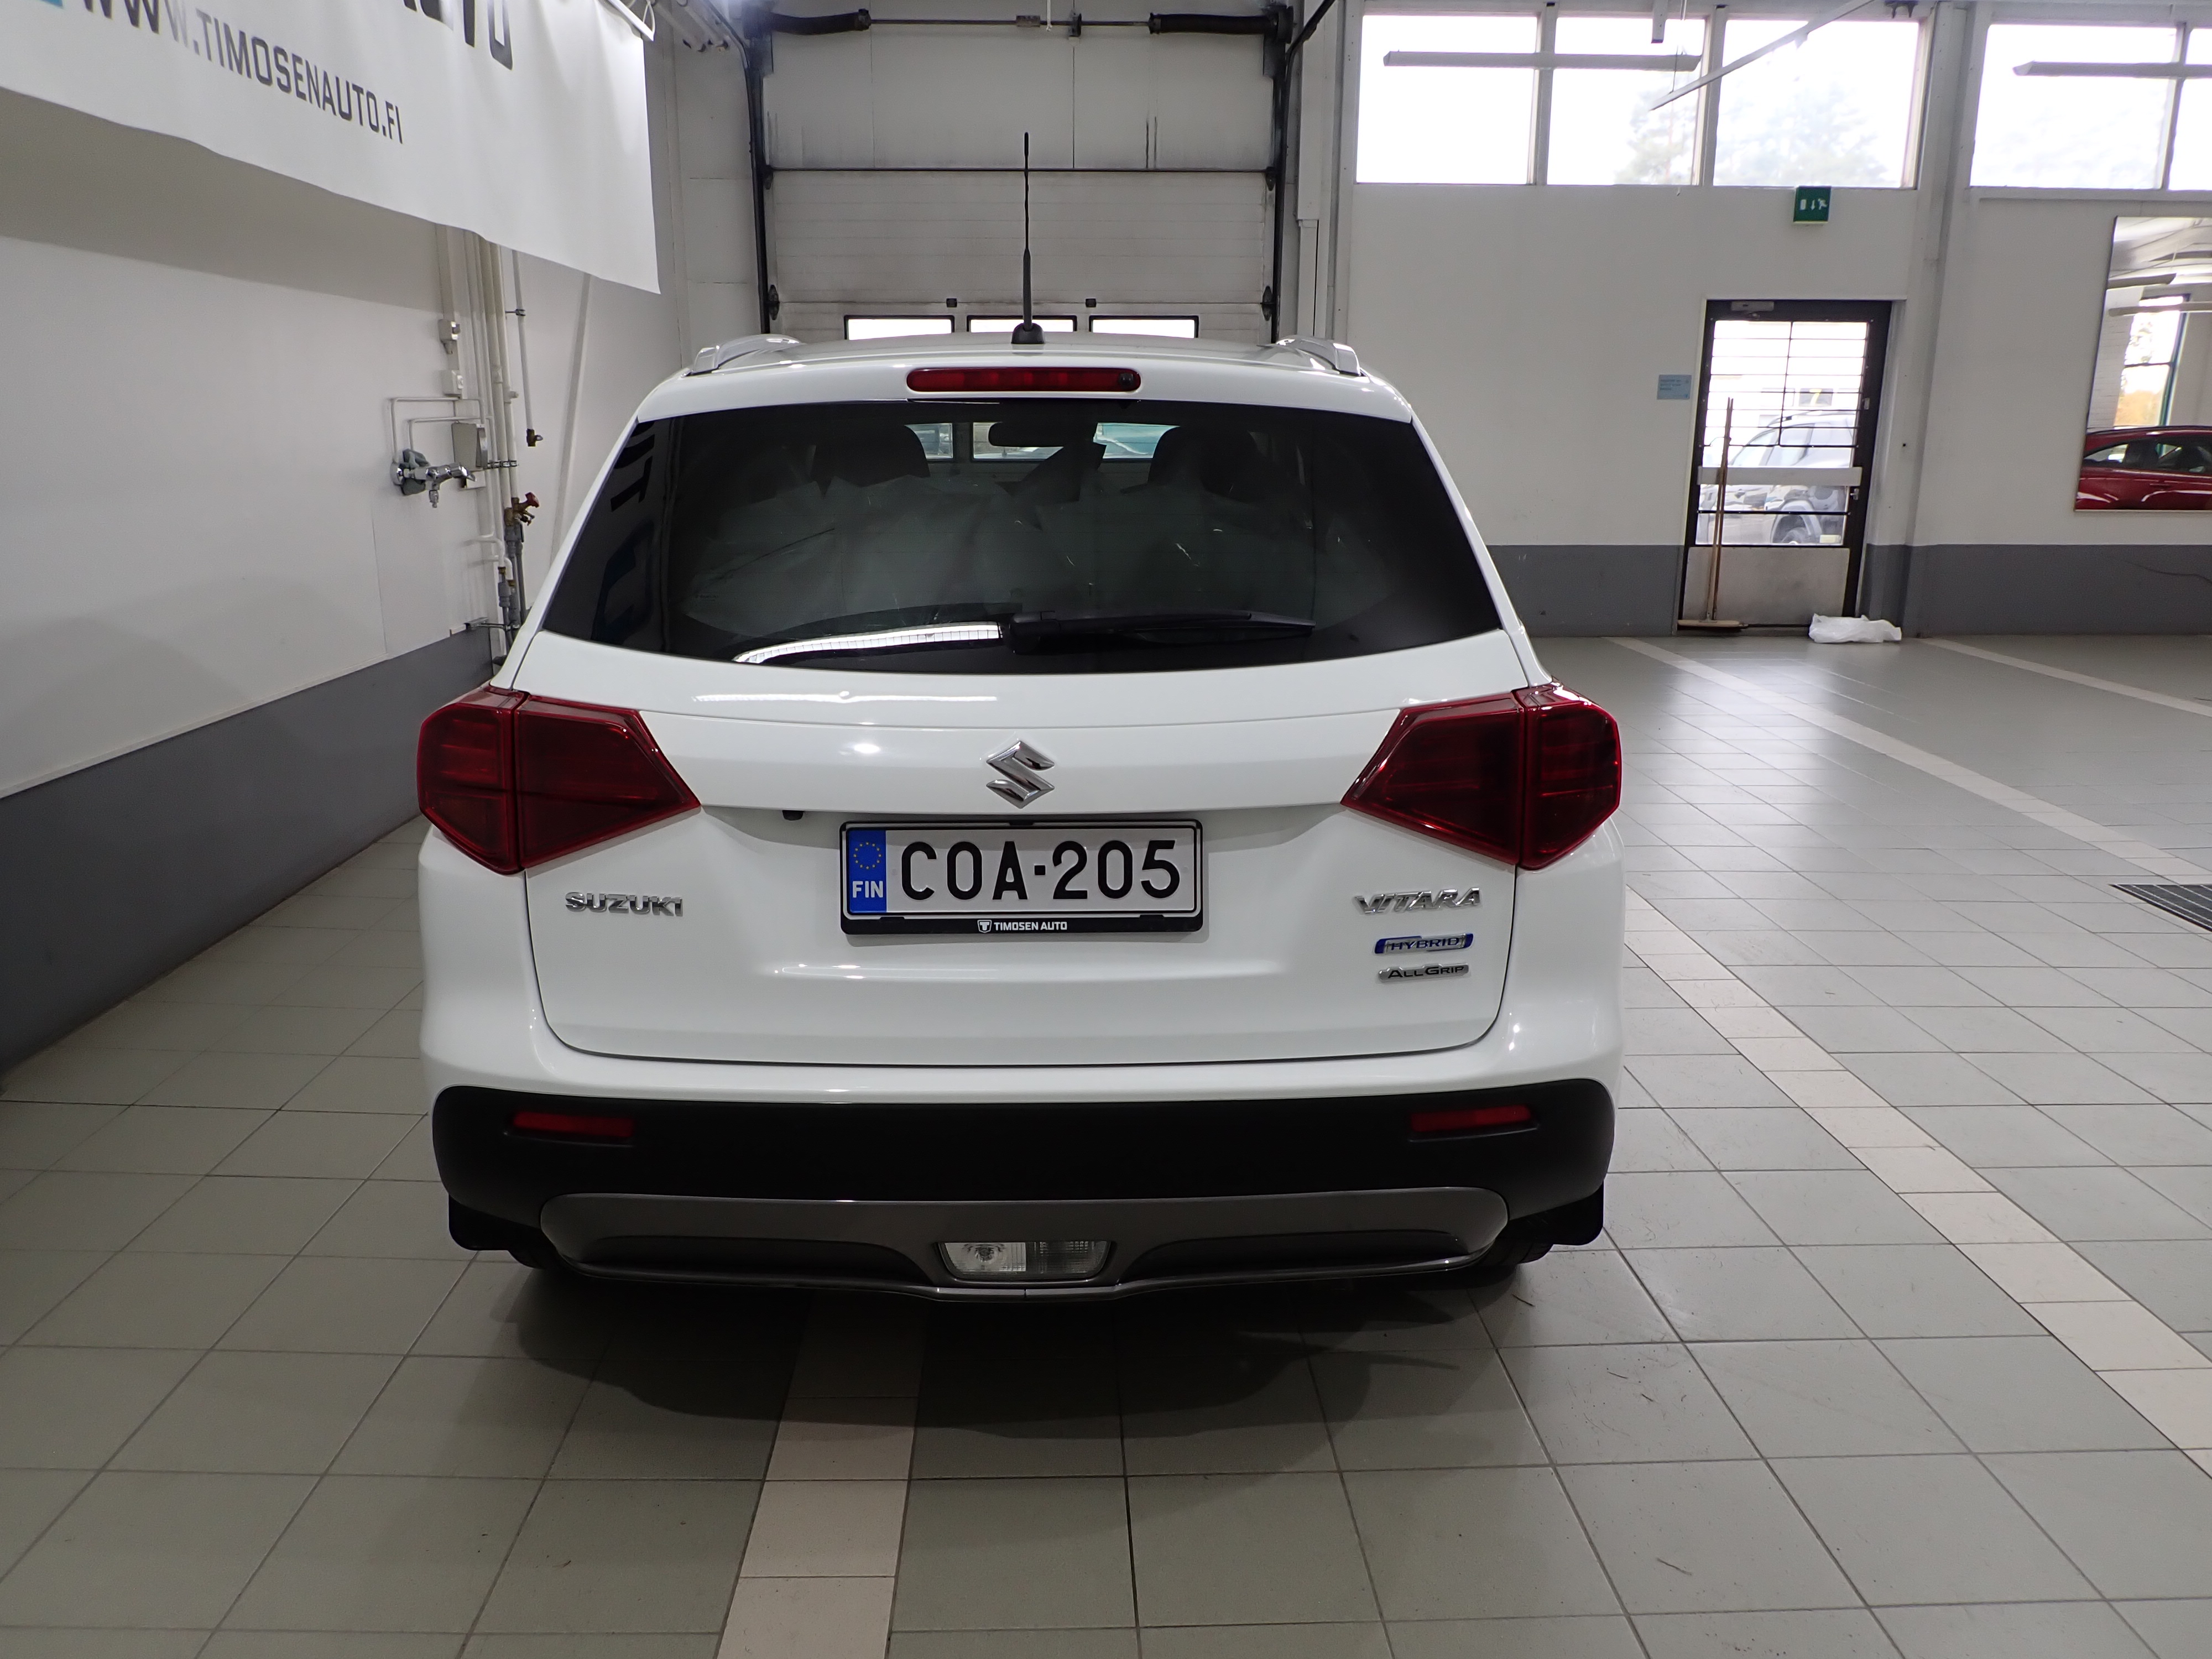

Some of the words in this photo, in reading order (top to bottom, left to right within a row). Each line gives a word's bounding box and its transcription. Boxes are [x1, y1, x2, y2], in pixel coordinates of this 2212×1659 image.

[901, 841, 1180, 900] COA-205
[852, 880, 884, 898] FIN
[565, 891, 684, 916] SUZUKI
[1353, 887, 1481, 914] VITARA
[994, 922, 1039, 931] TIMOSEN
[1040, 921, 1068, 931] AUTO
[1391, 937, 1460, 950] HYBRID
